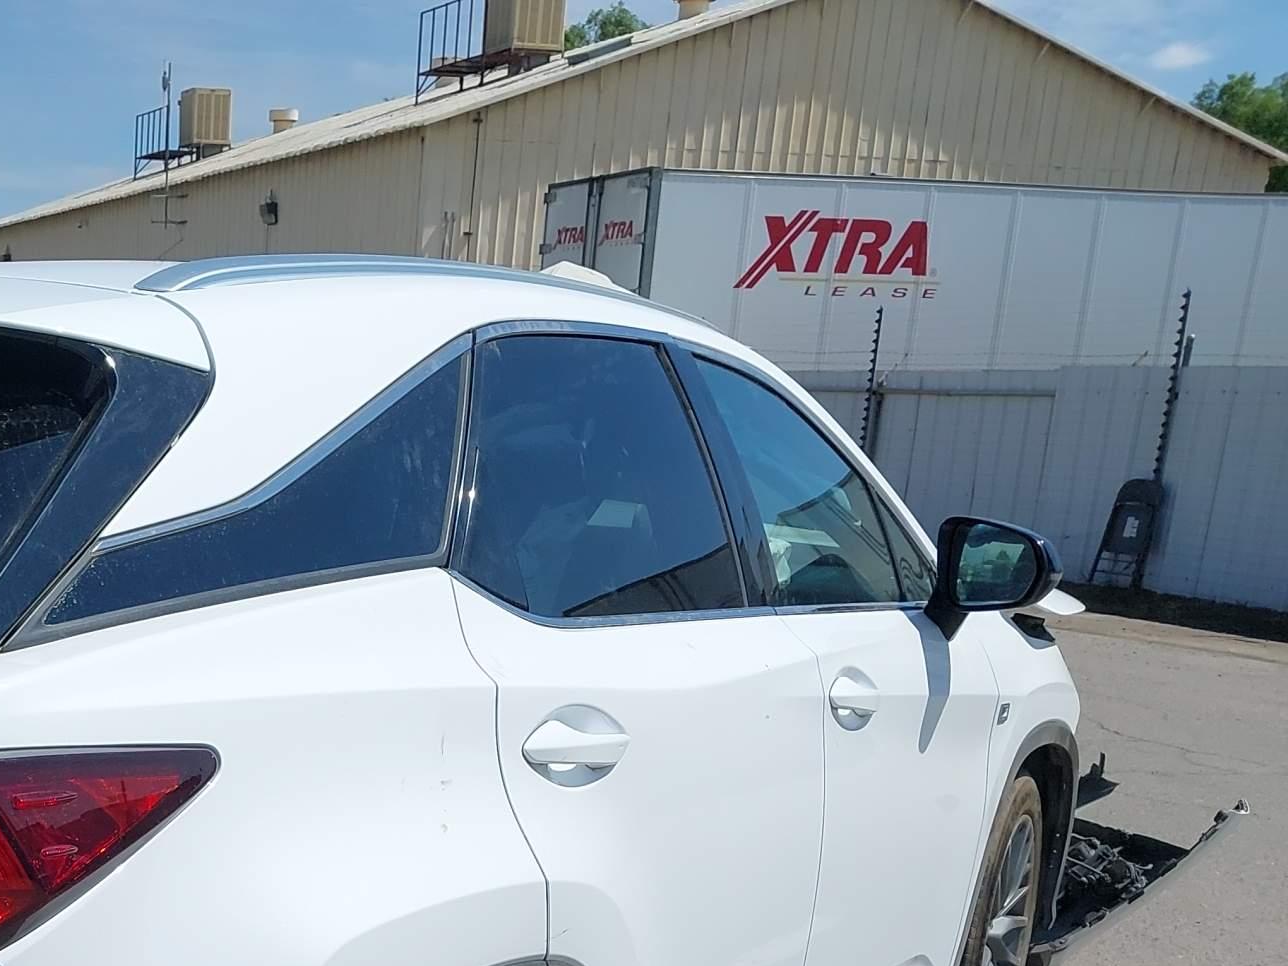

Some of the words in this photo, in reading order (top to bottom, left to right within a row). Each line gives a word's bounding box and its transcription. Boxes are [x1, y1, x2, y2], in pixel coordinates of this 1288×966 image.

[599, 220, 633, 246] XTRA
[733, 210, 928, 288] XTRA
[804, 286, 937, 299] LEASE
